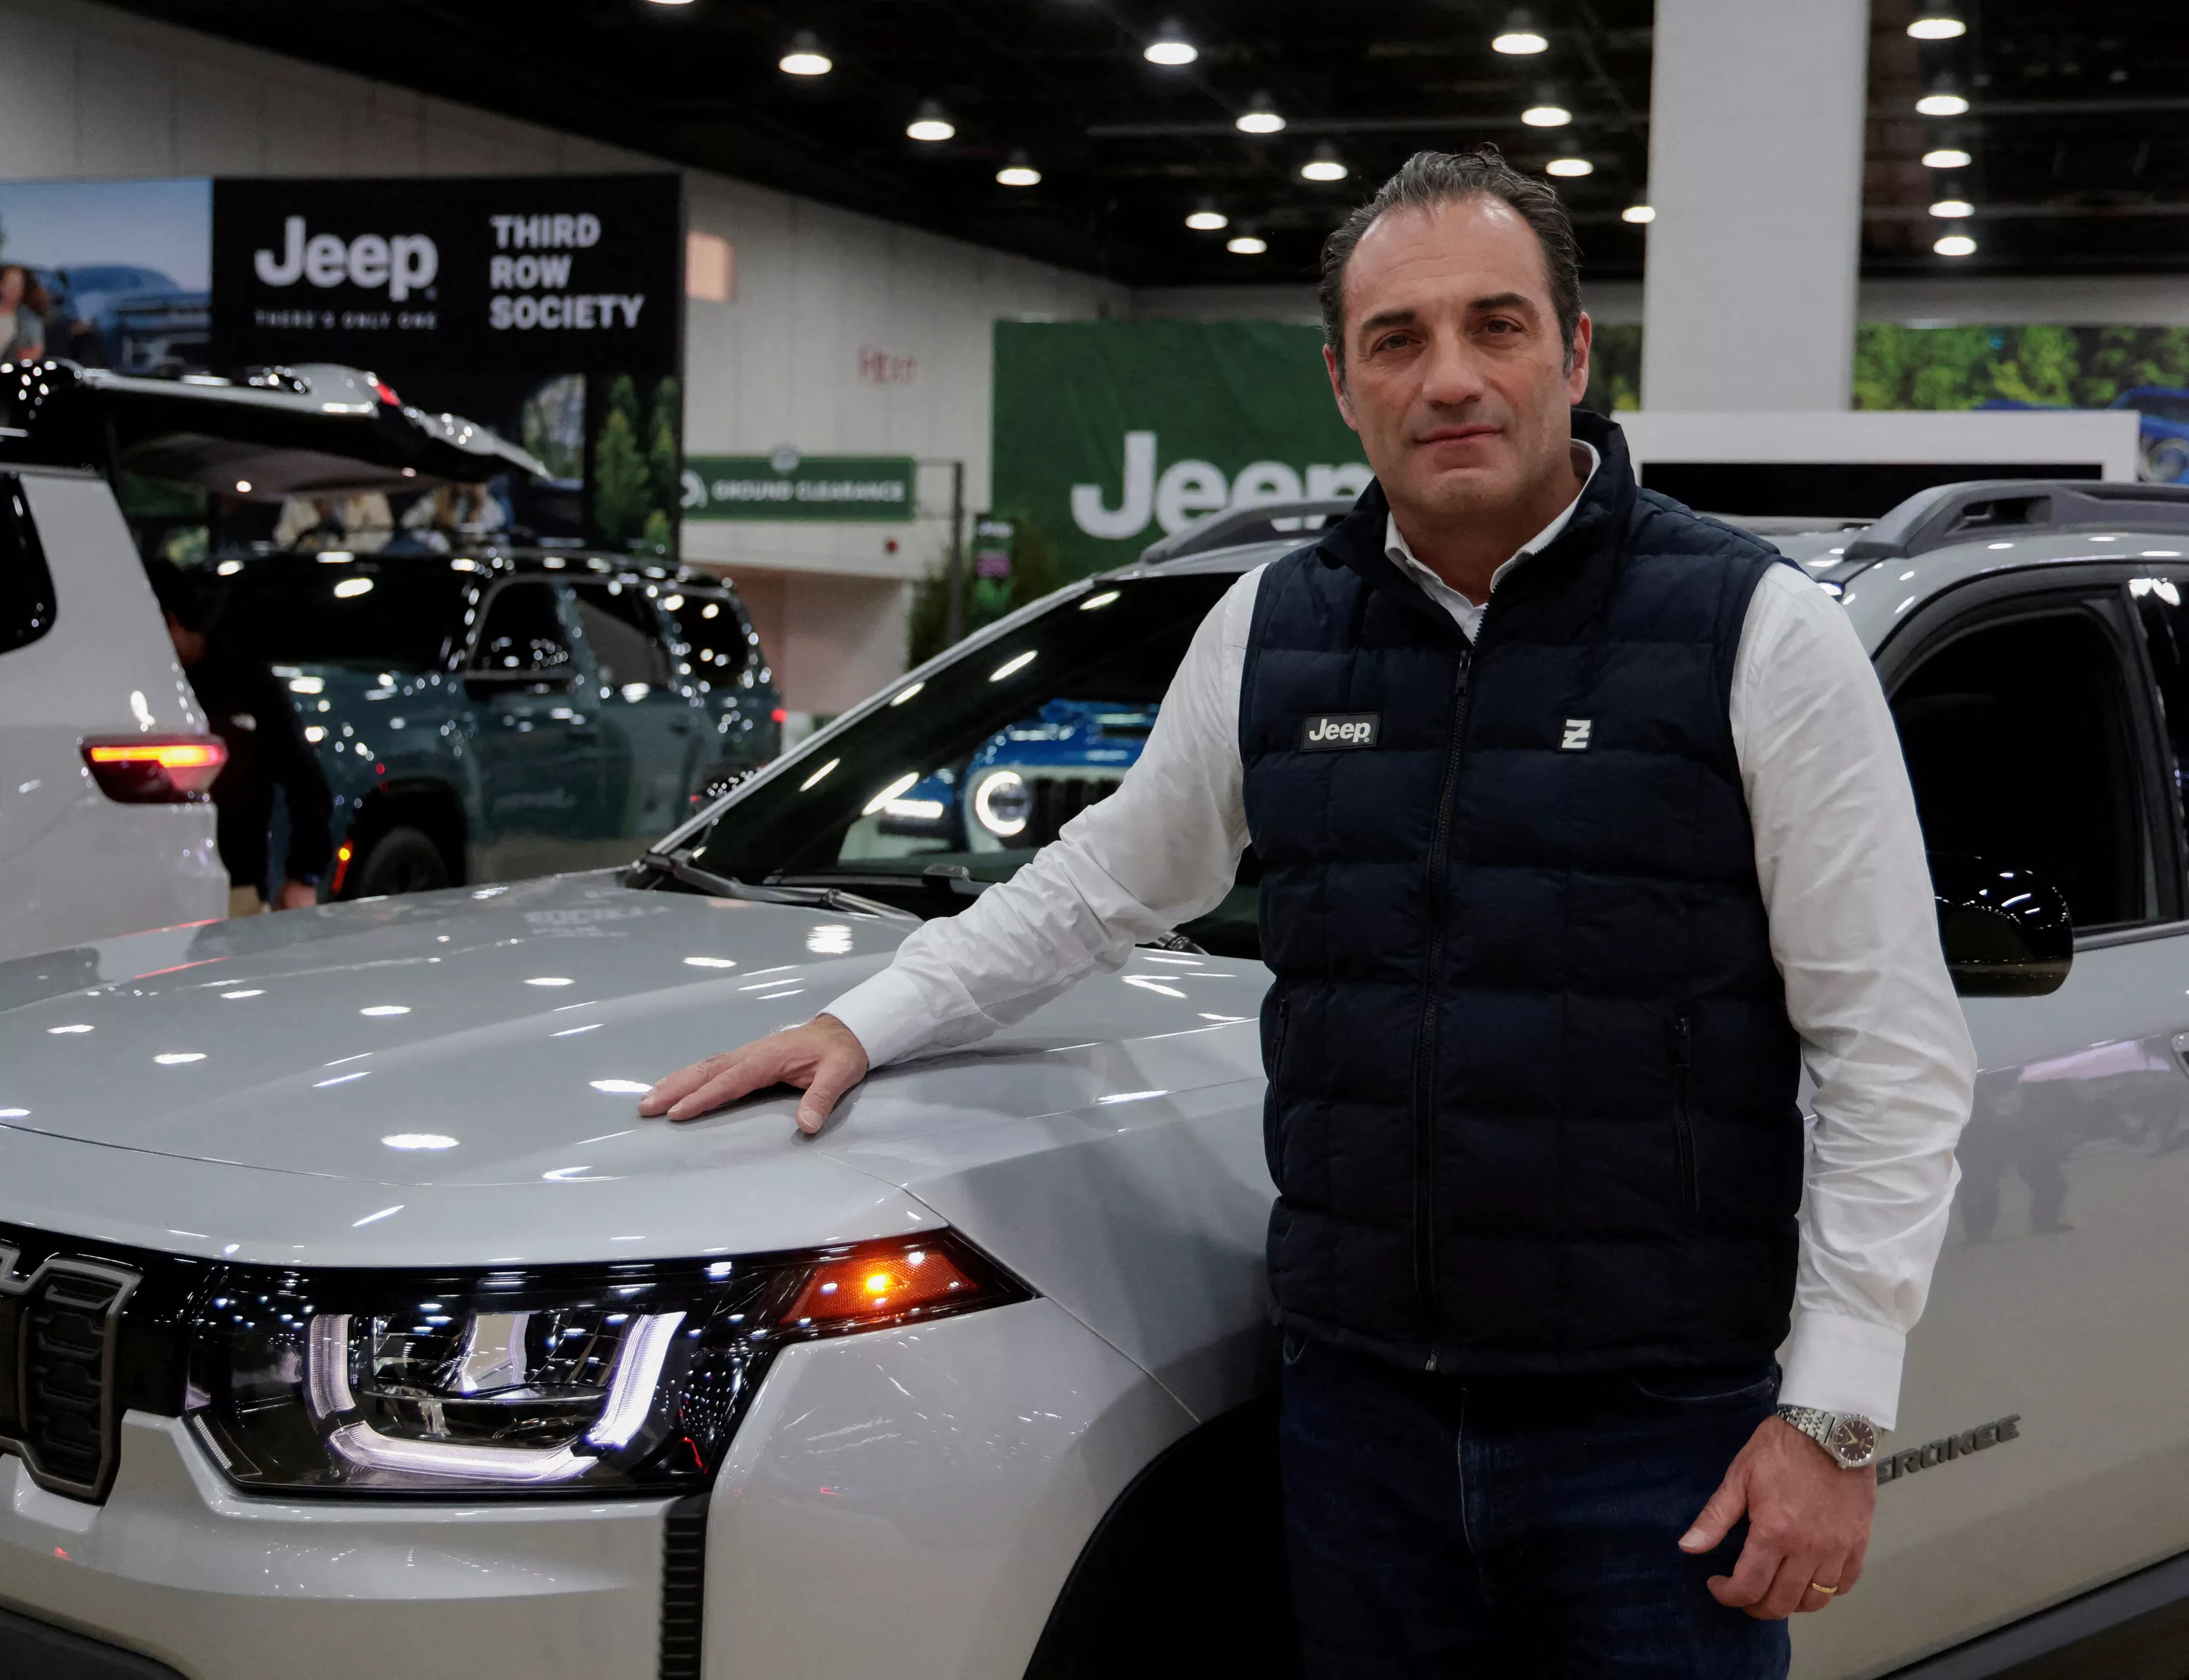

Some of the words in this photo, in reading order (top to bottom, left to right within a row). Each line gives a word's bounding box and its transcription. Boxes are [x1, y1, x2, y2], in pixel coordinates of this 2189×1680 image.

[489, 213, 601, 249] THIRD
[255, 216, 437, 301] Jeep
[490, 255, 572, 289] ROW
[398, 311, 437, 329] ONE
[489, 294, 645, 329] SOCIETY
[711, 479, 794, 502] GROUND
[796, 479, 906, 502] CLEARANCE
[1309, 719, 1371, 743] Jeep
[1875, 1414, 2020, 1485] EROKEE
